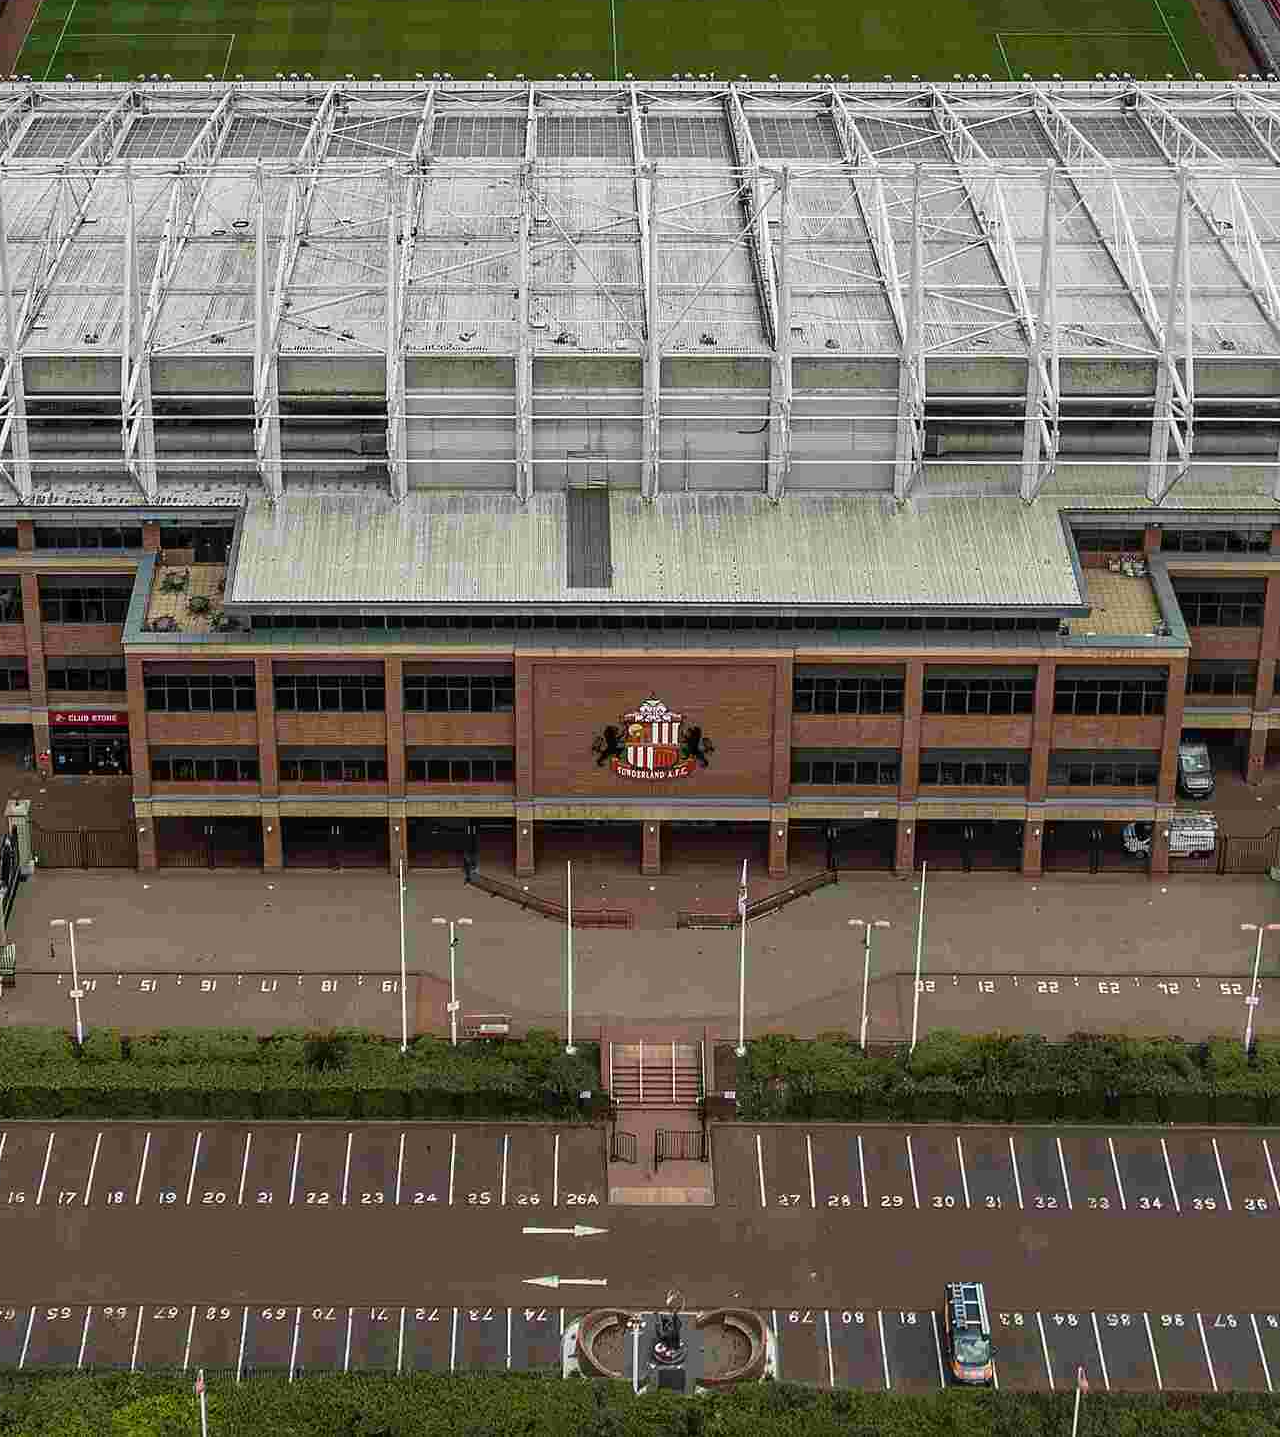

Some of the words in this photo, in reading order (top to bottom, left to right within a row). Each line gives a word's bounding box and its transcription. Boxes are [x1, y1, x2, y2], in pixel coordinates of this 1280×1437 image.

[140, 980, 156, 992] 15
[200, 980, 216, 992] 16
[260, 980, 277, 992] 17
[322, 980, 338, 992] 18
[382, 981, 397, 993] 19
[978, 981, 994, 992] 21
[1037, 982, 1058, 993] 22
[1098, 982, 1120, 994] 23
[1158, 982, 1180, 994] 24
[1220, 984, 1243, 995] 25
[8, 1192, 25, 1203] 16
[58, 1192, 76, 1203] 17
[107, 1192, 124, 1203] 18
[159, 1192, 176, 1203] 19
[202, 1193, 225, 1203] 20
[257, 1193, 272, 1203] 21
[306, 1193, 329, 1204] 22
[361, 1193, 383, 1203] 23
[414, 1193, 437, 1203] 24
[468, 1193, 490, 1204] 25
[518, 1193, 540, 1204] 26
[567, 1194, 599, 1204] 26A
[828, 1195, 850, 1206] 28
[880, 1196, 903, 1207] 29
[933, 1196, 955, 1207] 30
[986, 1196, 1001, 1207] 31
[1036, 1197, 1057, 1208] 32
[1140, 1199, 1163, 1209] 34
[1193, 1199, 1215, 1210] 35
[46, 1308, 71, 1319] 65
[153, 1309, 178, 1318] 67
[206, 1309, 231, 1319] 68
[262, 1309, 286, 1319] 69
[312, 1309, 336, 1319] 70
[371, 1309, 388, 1320] 71
[415, 1309, 439, 1320] 72
[468, 1309, 493, 1320] 73
[524, 1309, 547, 1320] 74
[789, 1312, 813, 1323] 79
[842, 1312, 864, 1323] 80
[900, 1312, 917, 1323] 81
[1000, 1314, 1023, 1325] 83
[1053, 1315, 1078, 1325] 84
[1107, 1314, 1131, 1325] 85
[1214, 1315, 1237, 1327] 87
